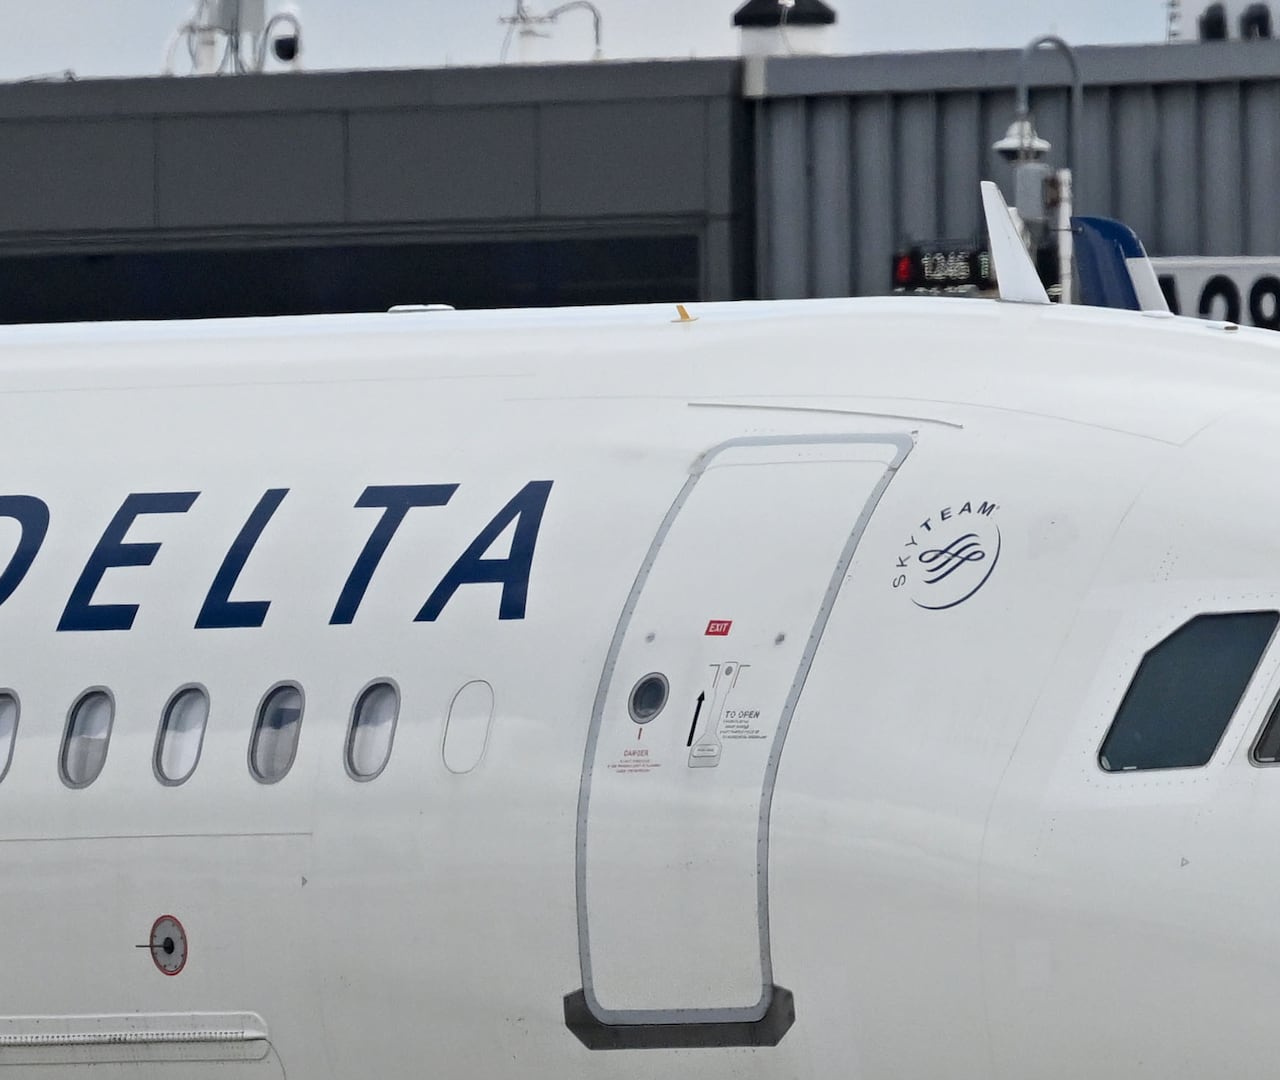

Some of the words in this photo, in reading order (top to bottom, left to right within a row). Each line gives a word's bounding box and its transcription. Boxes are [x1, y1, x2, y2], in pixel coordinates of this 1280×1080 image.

[892, 501, 996, 588] SKYTEAM
[708, 622, 730, 633] EXIT
[725, 710, 736, 718] TO
